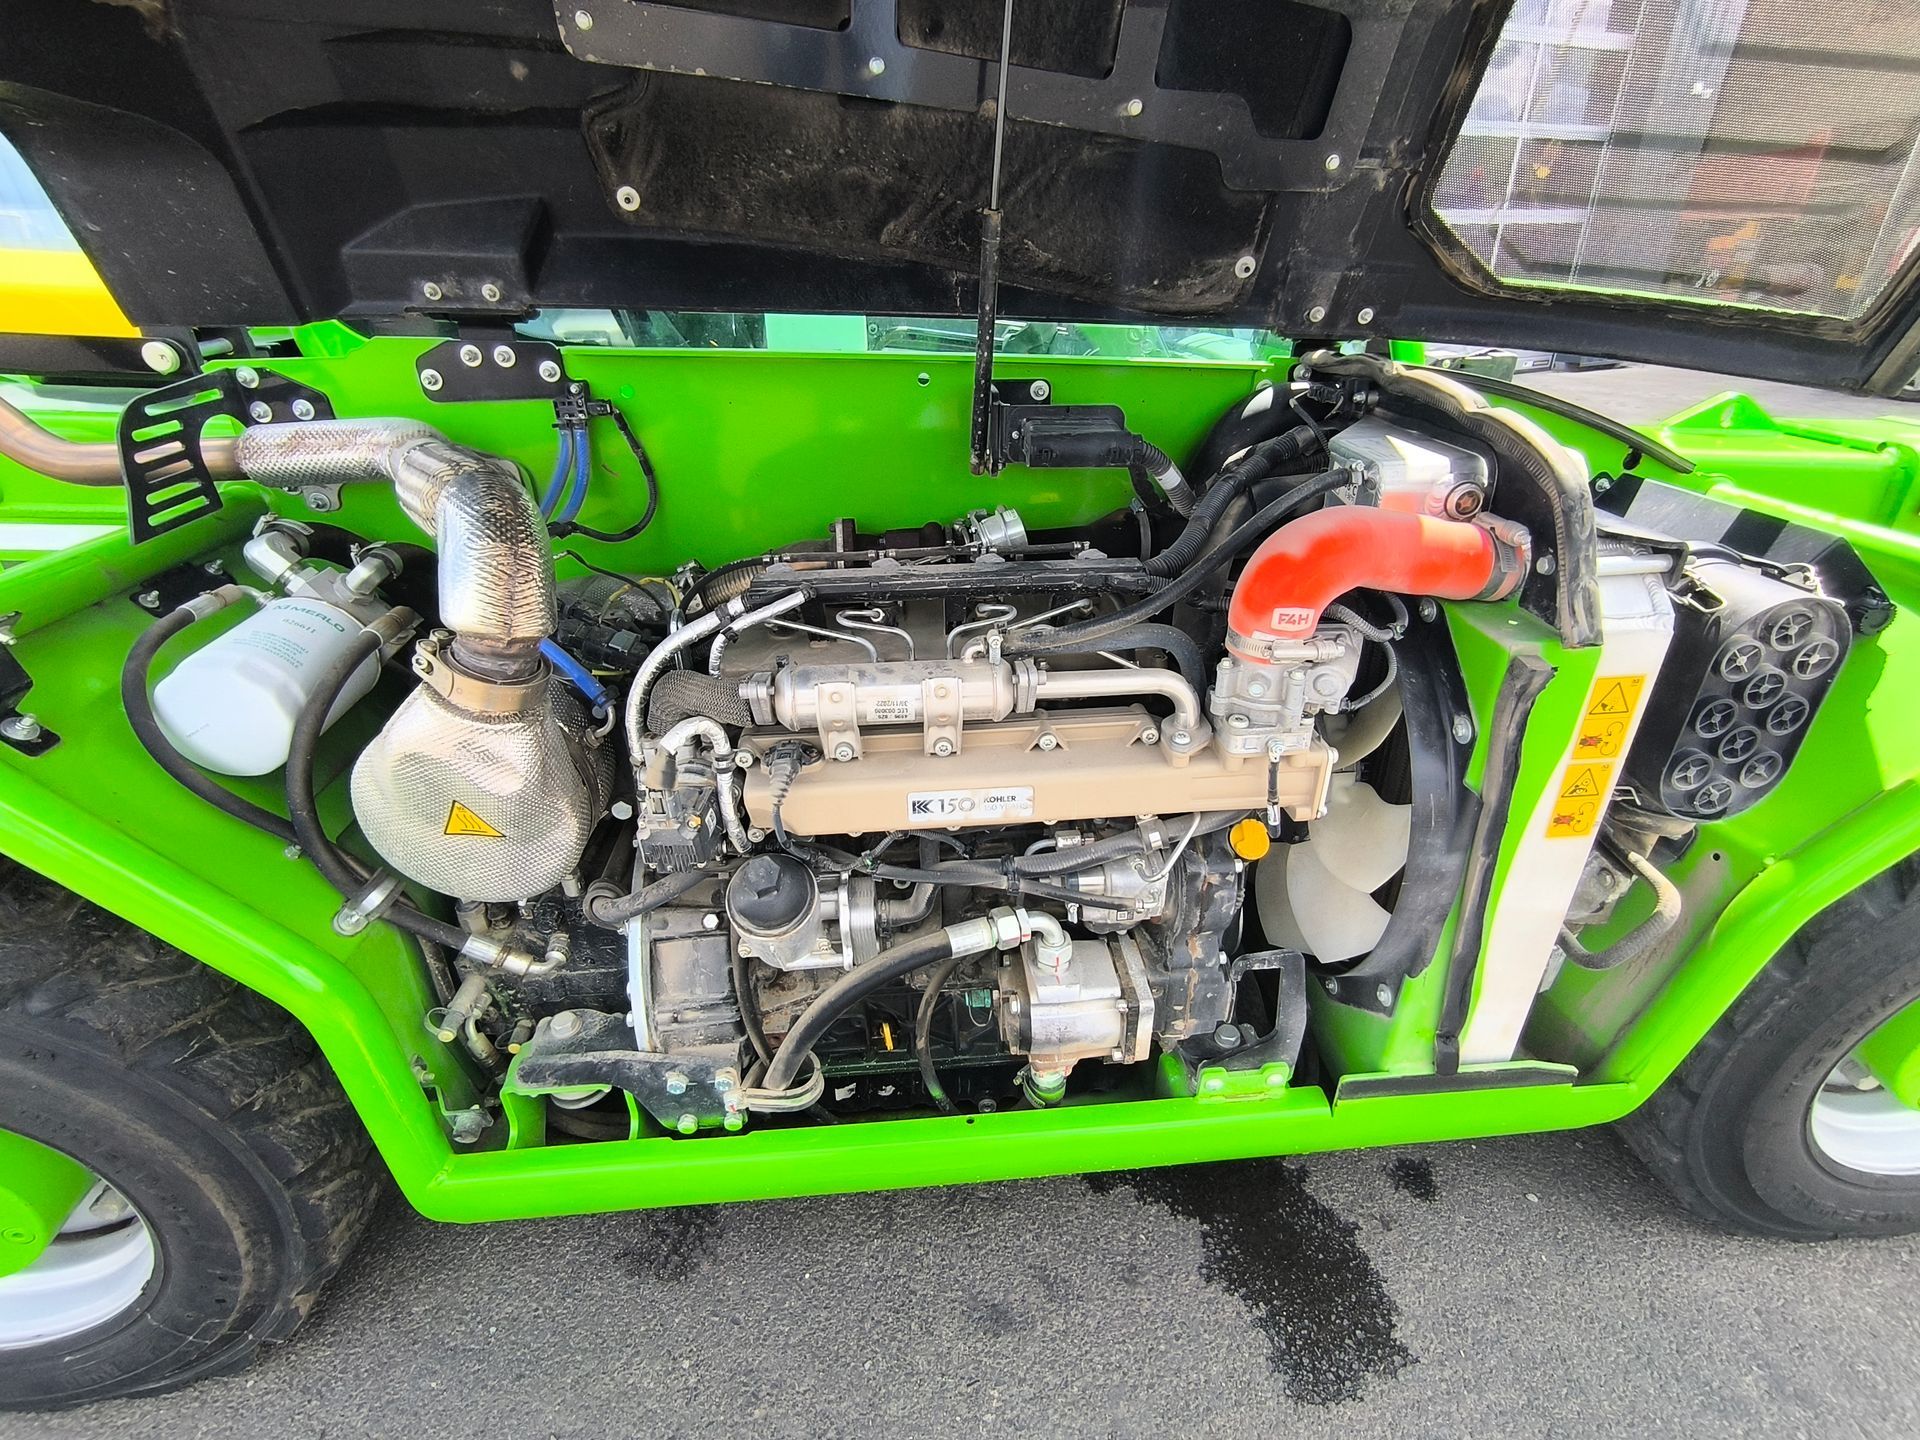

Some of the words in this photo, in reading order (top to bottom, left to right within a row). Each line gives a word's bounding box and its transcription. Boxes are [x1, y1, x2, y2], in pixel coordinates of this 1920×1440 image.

[291, 605, 346, 633] MERLO
[1277, 613, 1310, 625] F4H
[983, 795, 1017, 804] KOHLER
